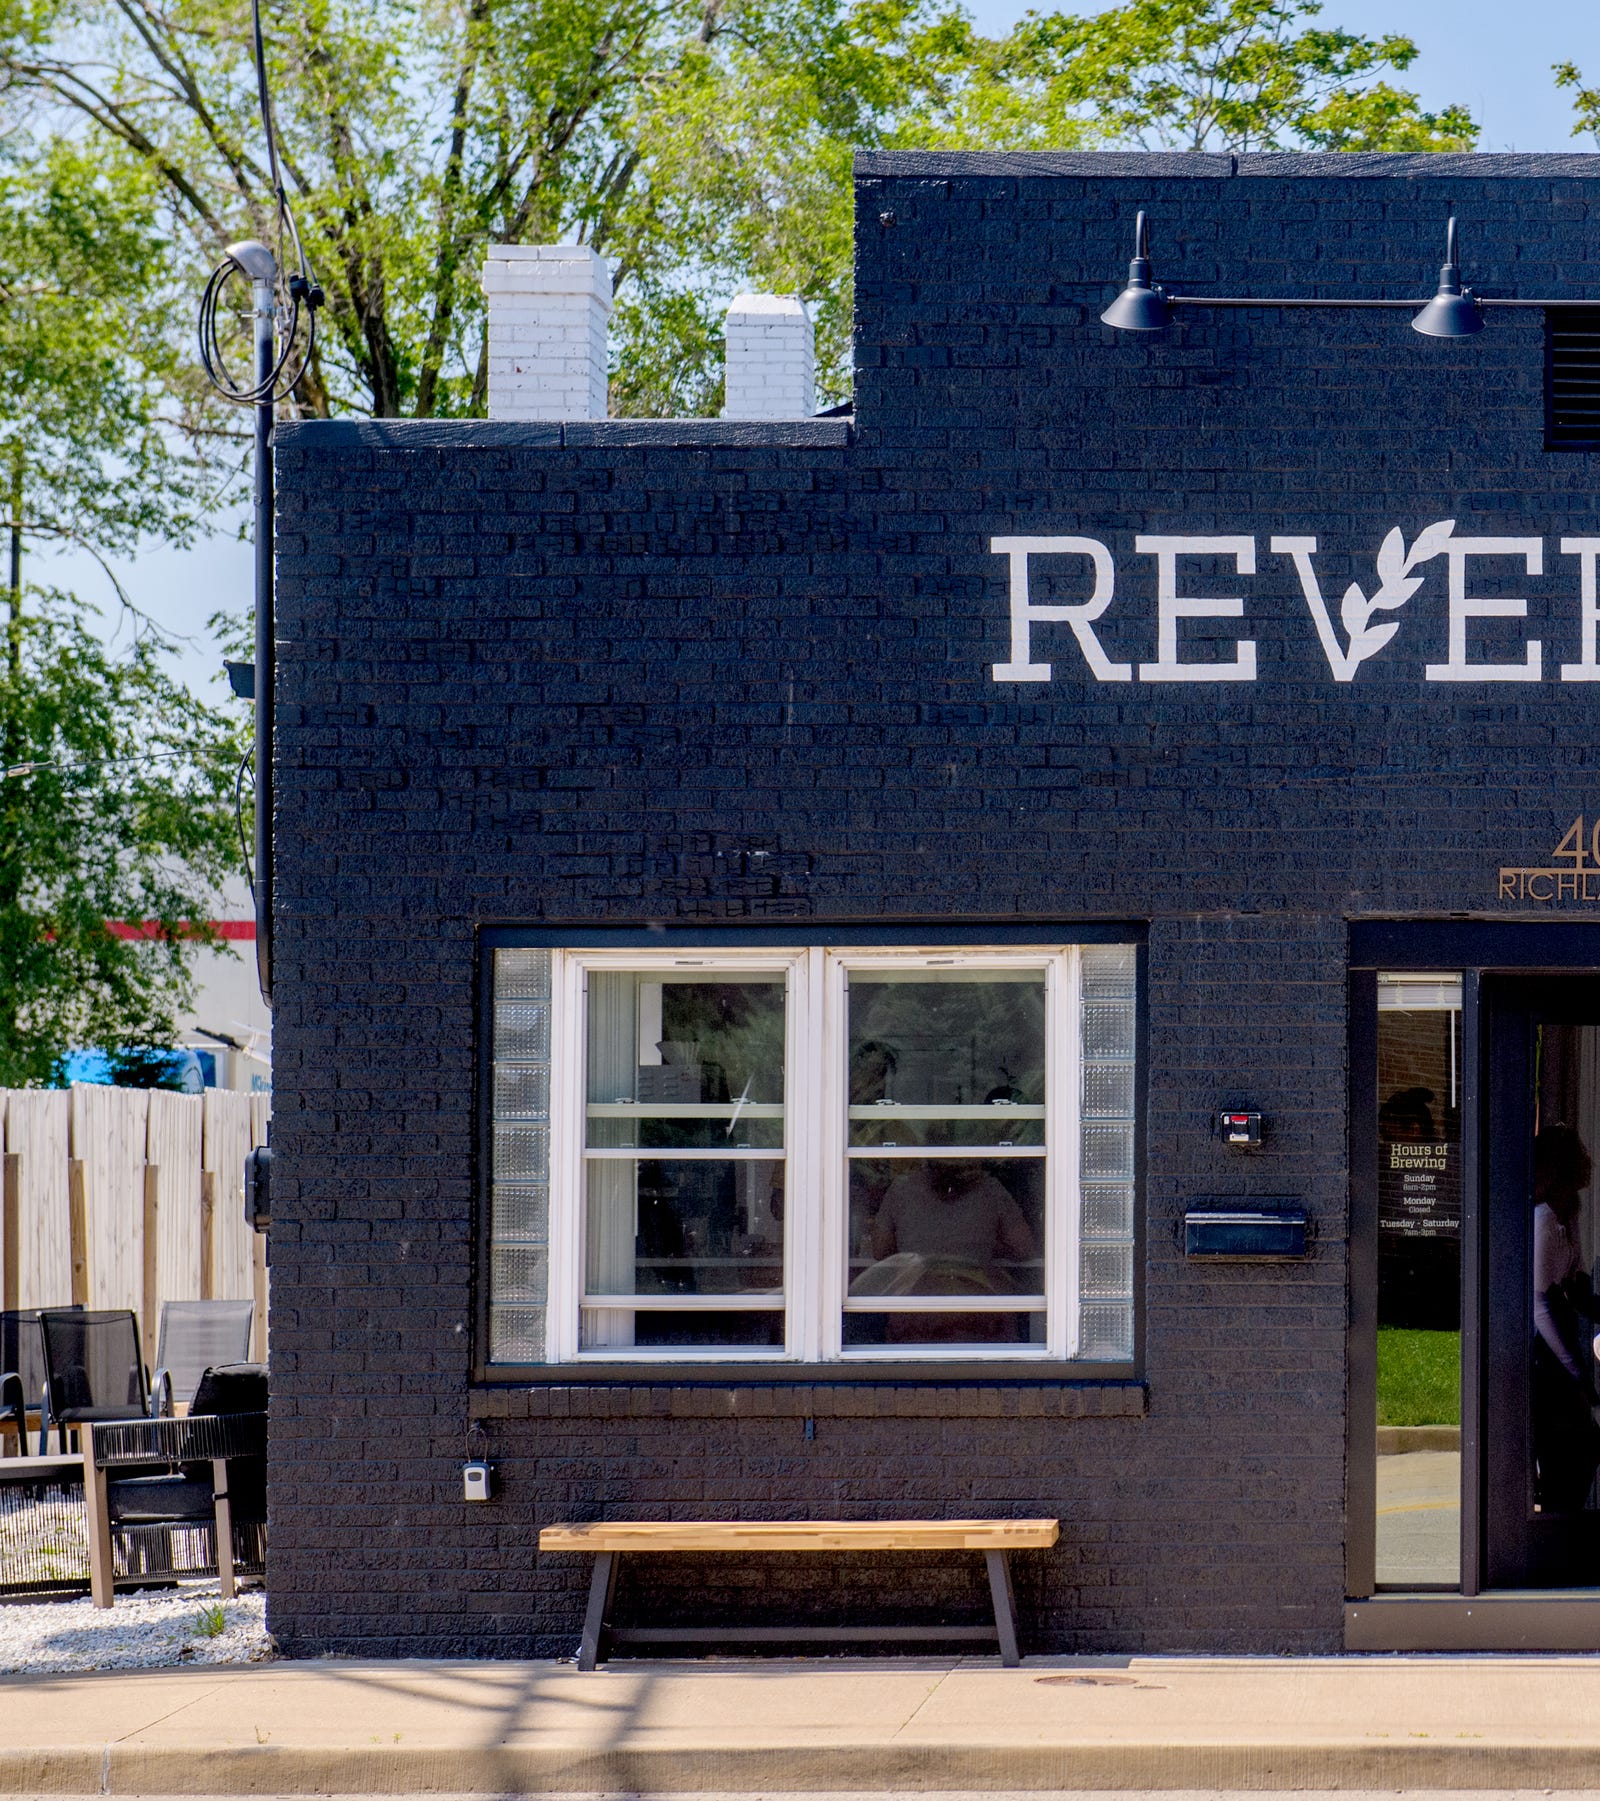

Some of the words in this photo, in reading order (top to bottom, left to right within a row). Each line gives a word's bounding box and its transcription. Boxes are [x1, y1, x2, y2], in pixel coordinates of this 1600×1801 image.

[1390, 1143, 1432, 1156] Hours
[1435, 1143, 1448, 1156] of
[1390, 1156, 1447, 1170] Brewing
[1403, 1174, 1436, 1183] Sunday
[1403, 1184, 1436, 1192] 8am-2pm
[1403, 1197, 1437, 1206] Monday
[1380, 1219, 1416, 1229] Tuesday
[1422, 1218, 1460, 1229] Saturday
[1403, 1228, 1436, 1236] 7am-3pm
